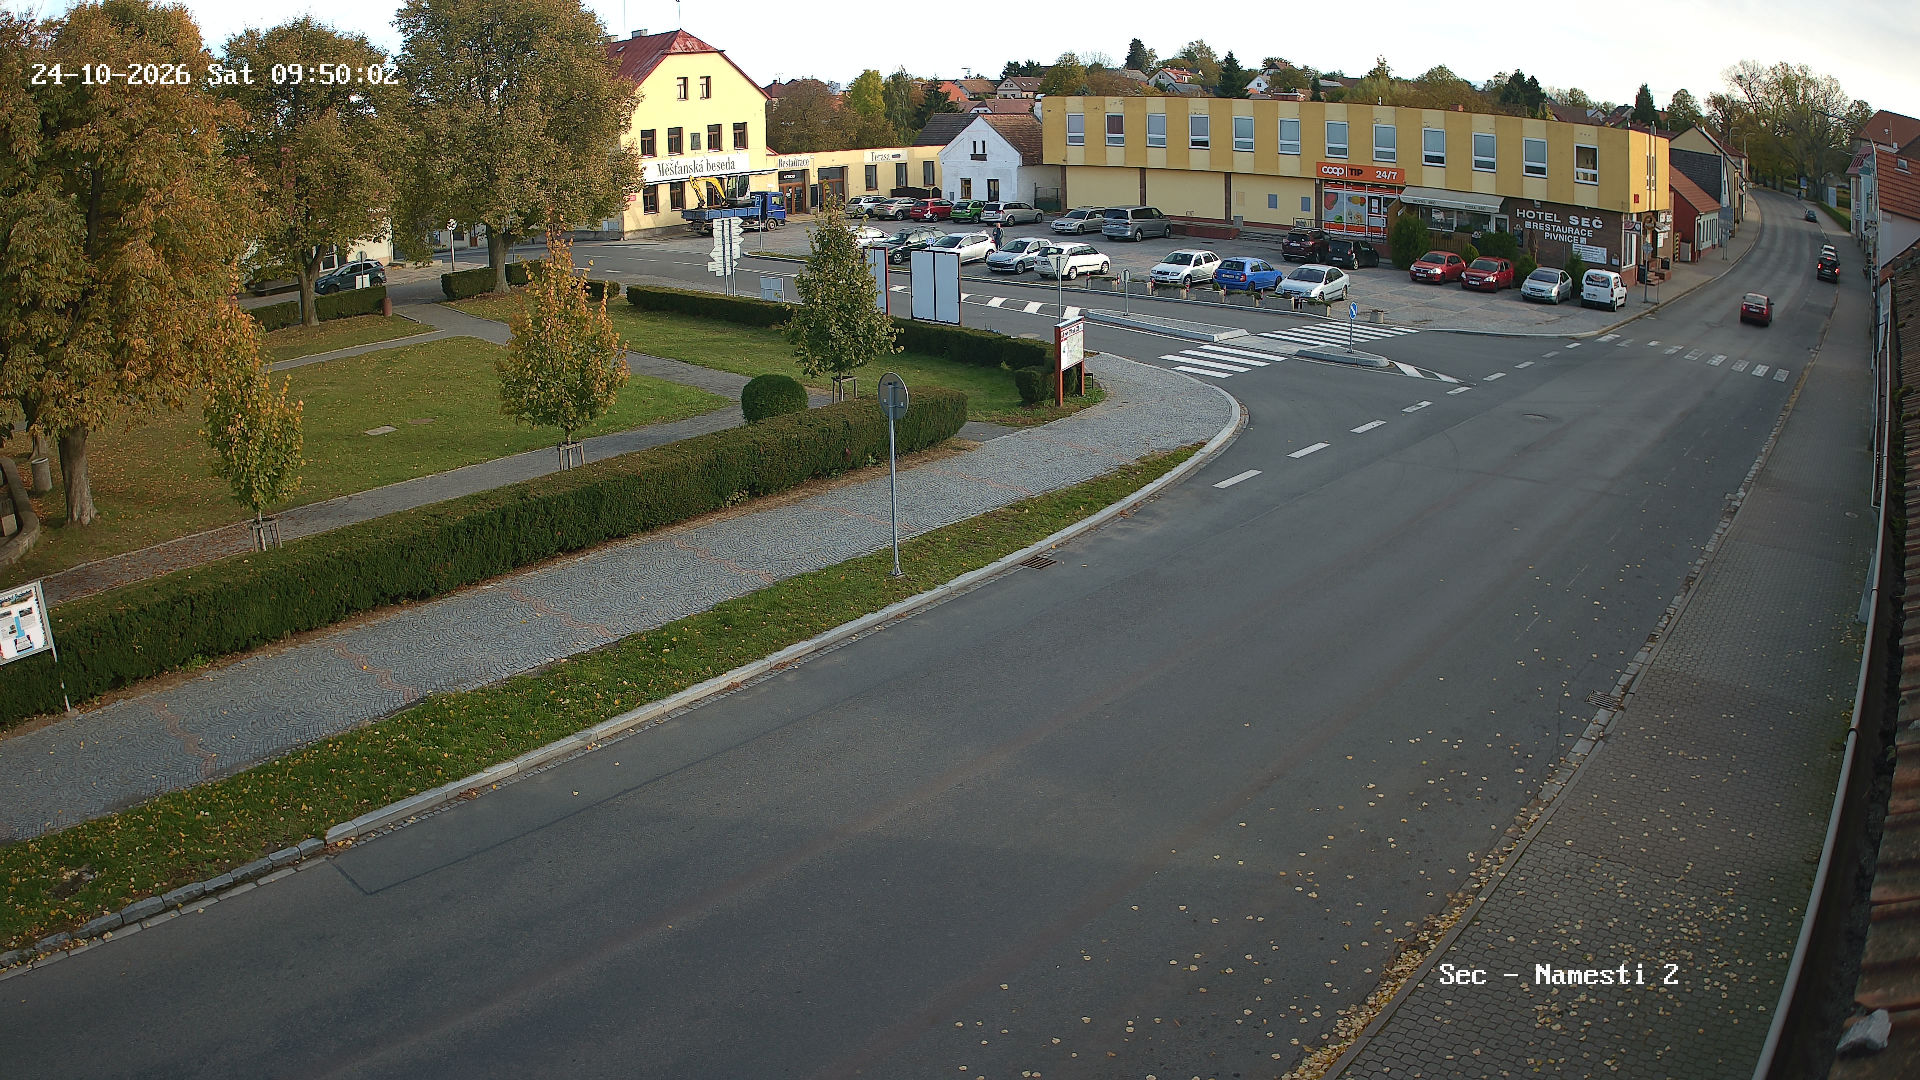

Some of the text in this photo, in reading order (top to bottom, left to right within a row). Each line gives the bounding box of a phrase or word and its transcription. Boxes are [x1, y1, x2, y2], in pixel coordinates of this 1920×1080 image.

[706, 157, 736, 172] beseda
[1321, 166, 1398, 180] coop TIP 24/7
[1516, 208, 1603, 229] HOTEL SEČ
[1532, 222, 1594, 238] RESTAURACE
[1544, 232, 1579, 244] PIVNICE
